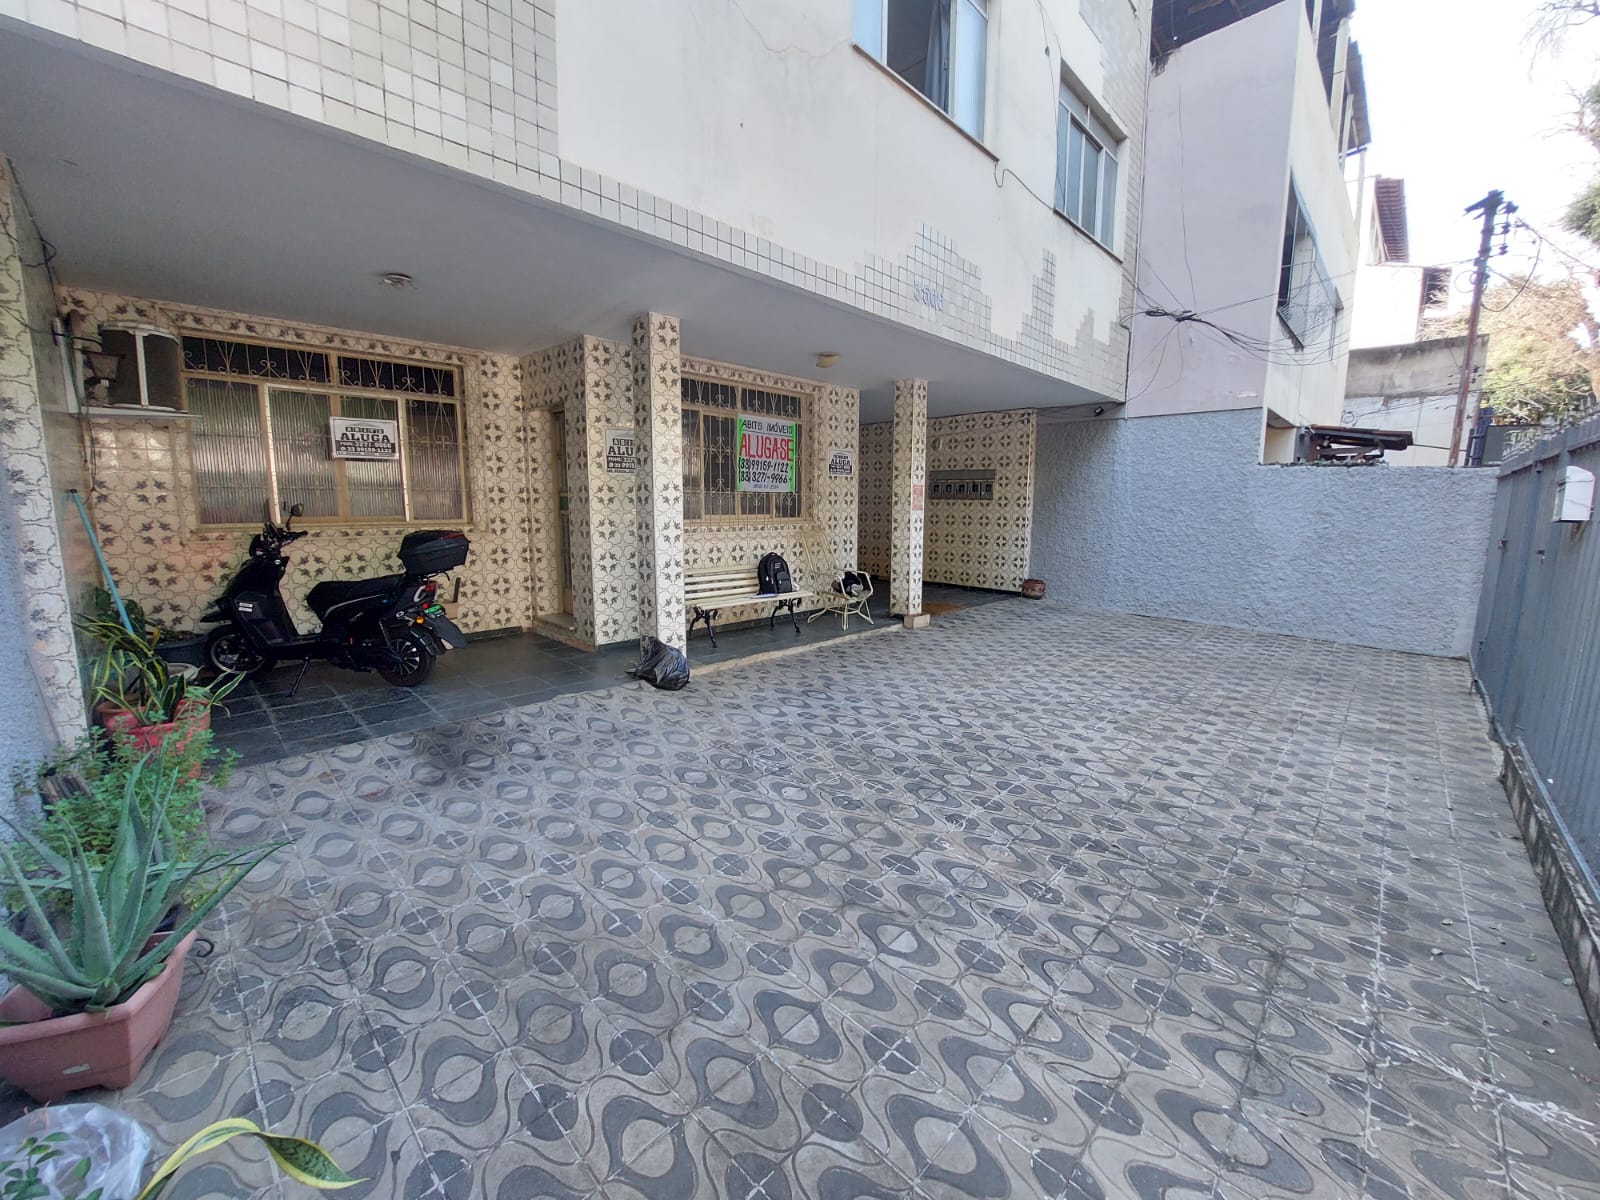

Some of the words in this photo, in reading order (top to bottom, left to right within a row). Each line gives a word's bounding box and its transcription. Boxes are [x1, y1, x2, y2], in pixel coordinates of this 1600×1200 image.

[741, 419, 763, 430] ABITS
[340, 432, 390, 442] ALUGA
[608, 446, 634, 456] ALU
[831, 458, 850, 466] ALUGA
